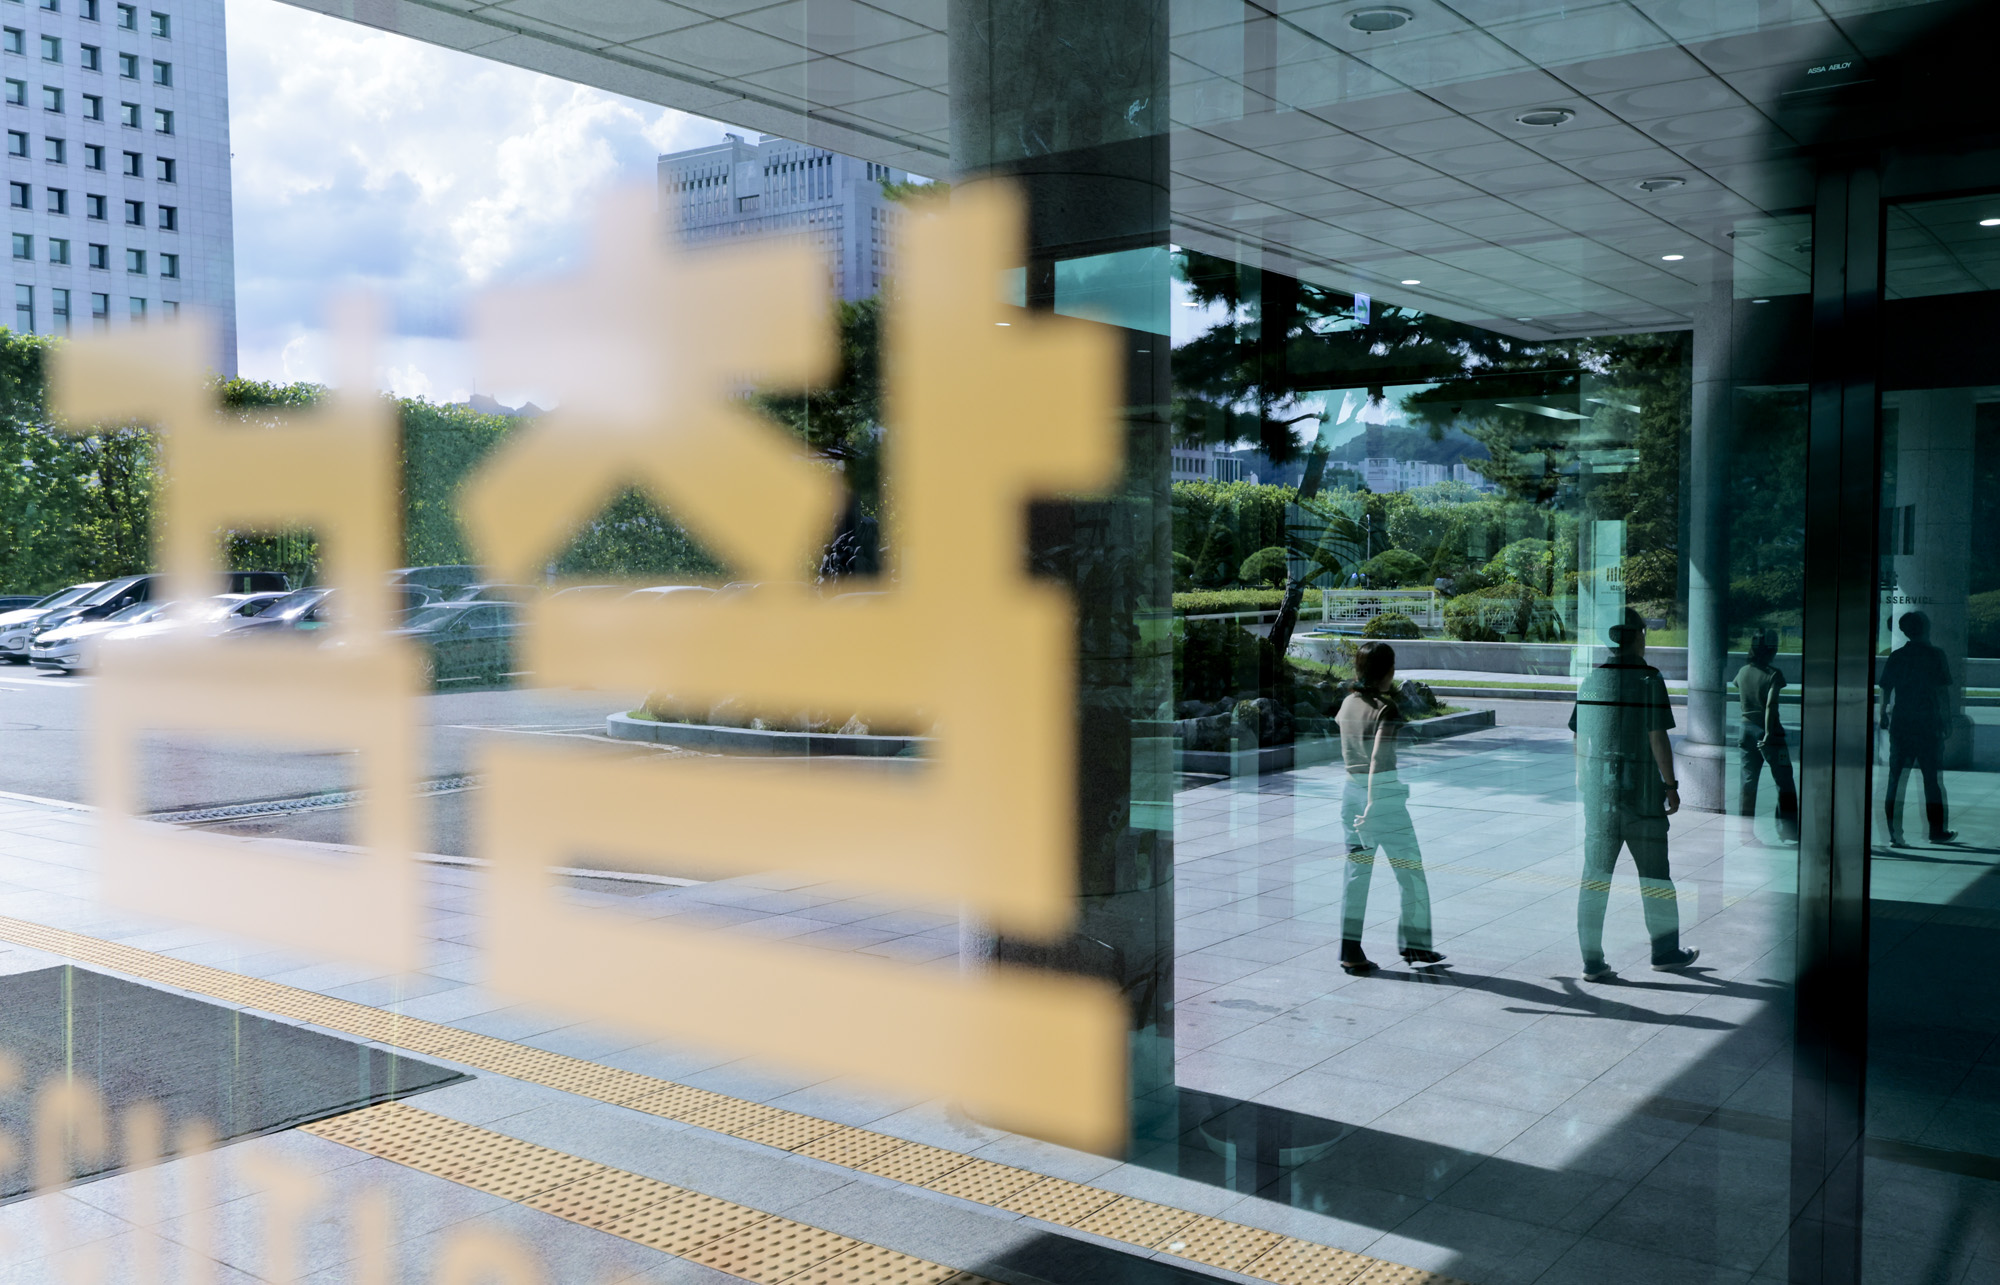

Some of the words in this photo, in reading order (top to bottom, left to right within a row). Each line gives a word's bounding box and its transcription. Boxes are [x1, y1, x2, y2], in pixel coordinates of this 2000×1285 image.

[1807, 66, 1826, 75] ASSA
[1828, 62, 1852, 71] ABLOY
[50, 178, 1128, 1156] 검찰
